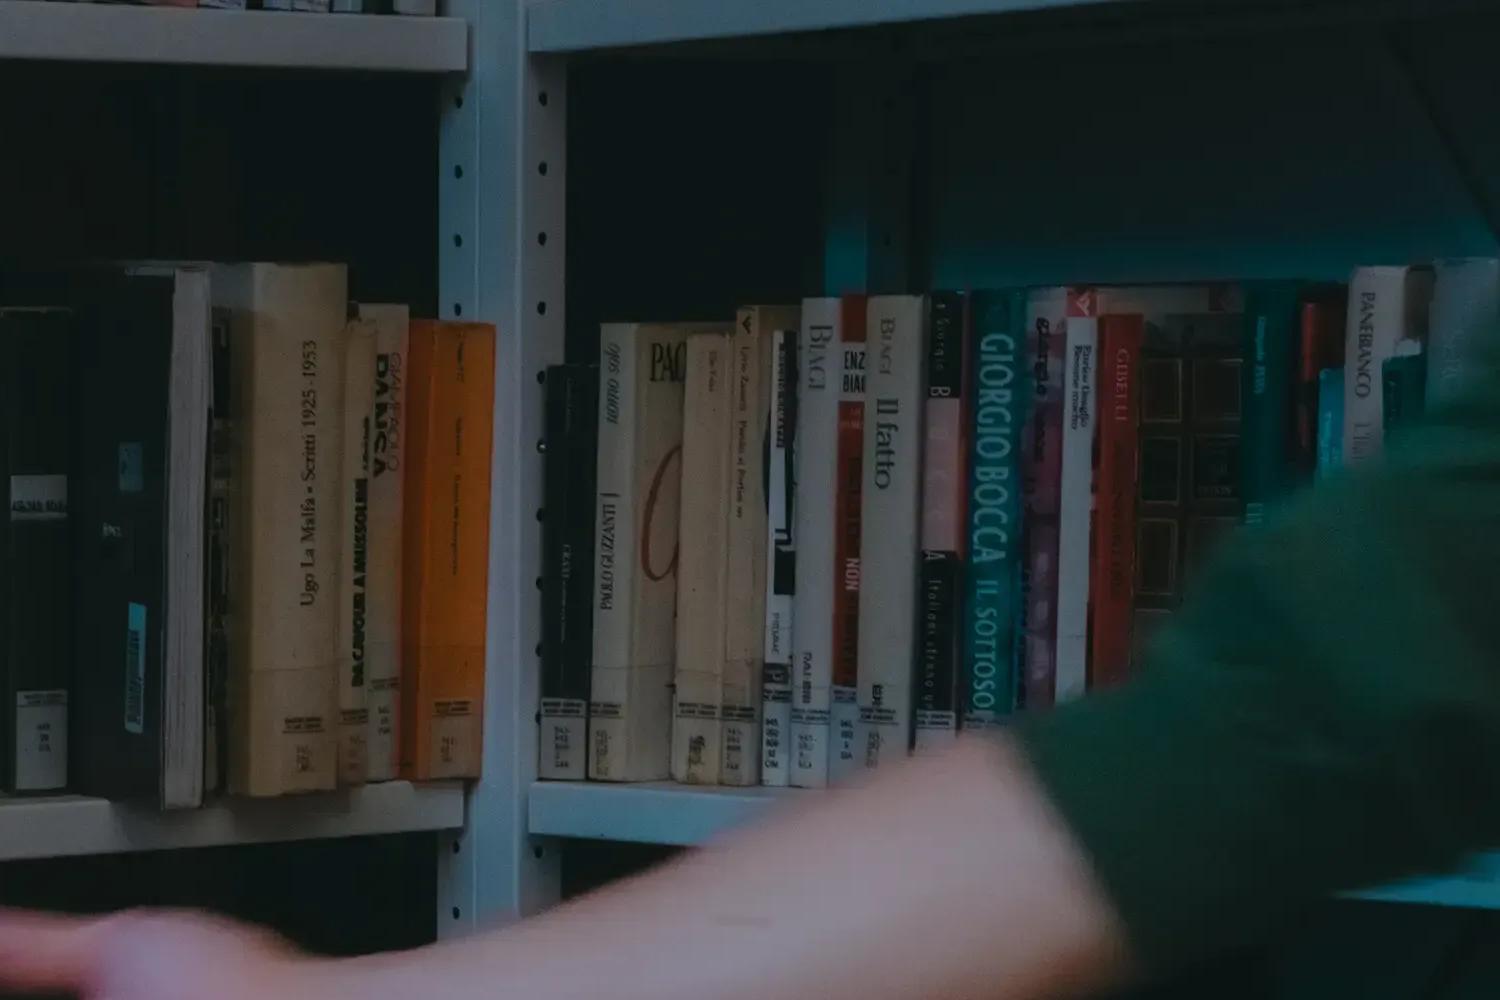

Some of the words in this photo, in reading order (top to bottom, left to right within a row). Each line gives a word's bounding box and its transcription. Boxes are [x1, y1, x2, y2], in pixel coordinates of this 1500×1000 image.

[602, 342, 621, 376] solo
[807, 324, 834, 391] BIAGI
[843, 350, 866, 371] ENZ
[878, 316, 896, 376] BIAGI
[1354, 292, 1376, 398] PANEBIANCO
[603, 378, 620, 425] uomo
[842, 374, 866, 394] BIA
[876, 397, 899, 415] Il
[976, 331, 1015, 459] GIORGIO
[372, 353, 389, 478] PANSA
[300, 433, 317, 482] Scritti
[874, 422, 899, 490] fatto
[1350, 423, 1370, 461] L'Ital
[300, 497, 316, 544] Malfa
[354, 477, 369, 574] MUSSOLINI
[599, 503, 617, 569] GUZZANTI
[972, 465, 1009, 565] BOCCA
[300, 549, 316, 568] La
[354, 575, 366, 588] A
[844, 557, 861, 591] NON
[300, 573, 320, 607] Ugo
[598, 571, 614, 611] PAOLO
[973, 579, 999, 598] IL
[352, 592, 367, 661] CAVOUR
[351, 661, 366, 688] DA
[972, 606, 997, 715] SOTTOSO
